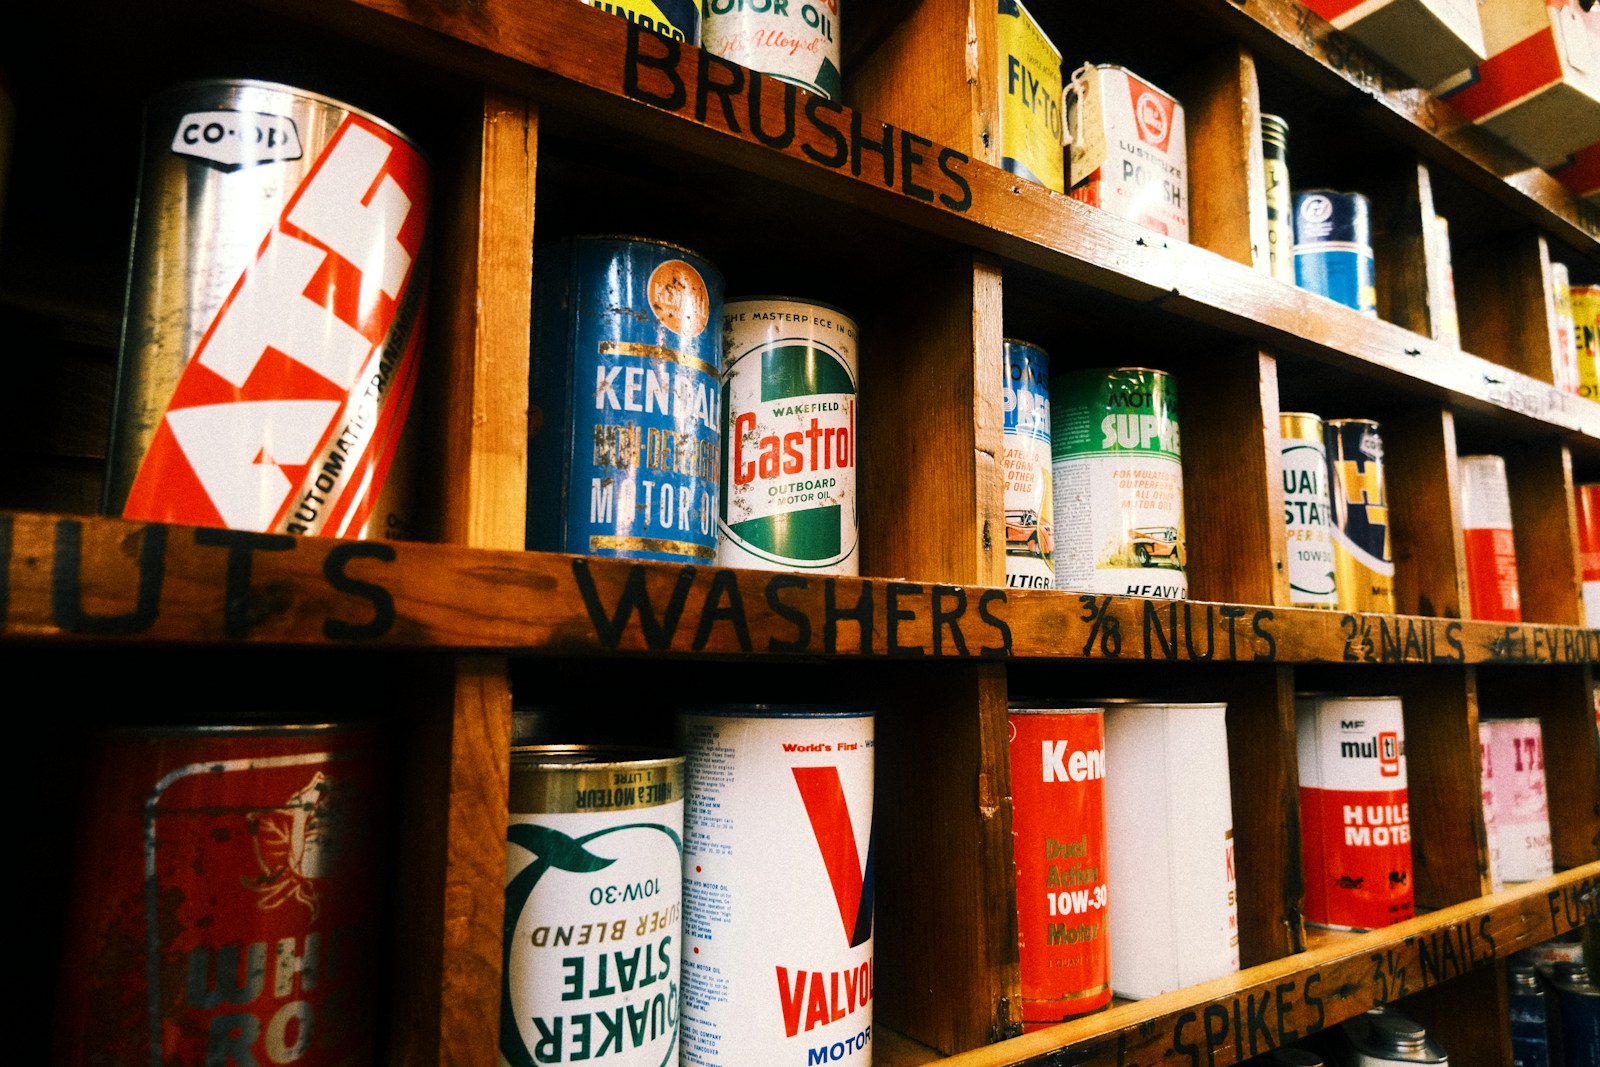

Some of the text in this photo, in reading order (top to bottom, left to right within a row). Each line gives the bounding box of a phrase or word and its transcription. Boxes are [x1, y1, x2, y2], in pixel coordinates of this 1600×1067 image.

[801, 4, 833, 43] OIL
[623, 21, 973, 212] BRUSHES
[166, 122, 413, 534] ATF
[752, 312, 832, 329] MASTERPIECE
[836, 323, 845, 333] IN
[772, 402, 839, 418] WAKEFIELD
[734, 400, 854, 486] Castrol
[590, 477, 690, 531] MOTOR
[768, 477, 836, 497] OUTBOARD
[777, 490, 830, 506] MOTOR OIL
[1013, 482, 1032, 493] OILS
[572, 559, 1013, 657] WASHERS
[1143, 599, 1277, 662] NUTS
[1381, 617, 1465, 664] NAILS
[1340, 720, 1365, 730] MF
[782, 743, 832, 752] World's
[837, 742, 858, 751] First
[614, 772, 642, 784] LITRE
[576, 787, 635, 809] MOTEUR
[1343, 802, 1410, 826] HUILE
[1045, 833, 1087, 860] Dual
[1047, 861, 1099, 888] Action
[1047, 883, 1107, 916] 10W-30
[531, 901, 681, 948] SUPER BLEND
[1047, 921, 1099, 945] Motor
[561, 935, 672, 1002] STATE
[1417, 914, 1497, 989] NAILS
[532, 979, 679, 1064] QUAKER
[1164, 972, 1326, 1067] SPIKES
[808, 1024, 871, 1067] MOTOR
